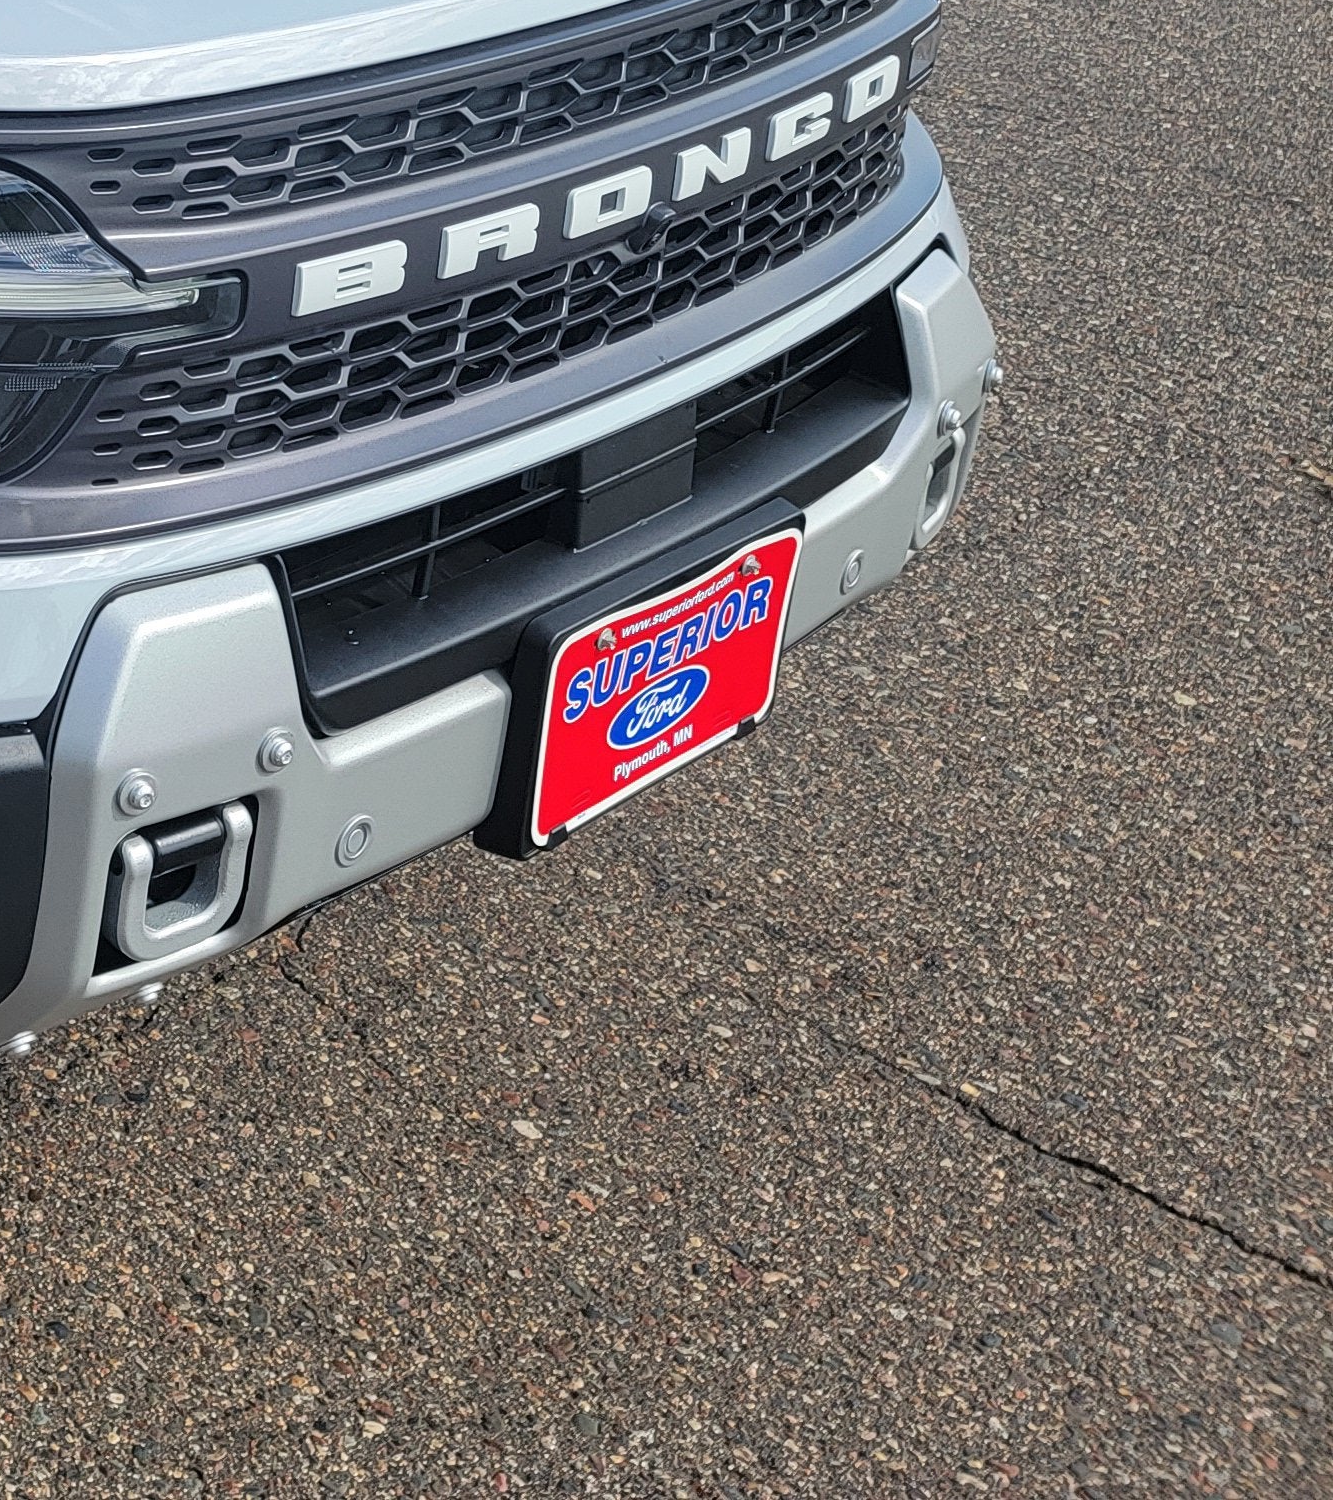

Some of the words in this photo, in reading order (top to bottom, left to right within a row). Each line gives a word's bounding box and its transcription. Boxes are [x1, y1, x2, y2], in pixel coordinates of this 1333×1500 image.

[291, 54, 900, 317] BRONCO
[621, 571, 735, 638] www.superiorford.com
[563, 576, 773, 723] SUPERIOR
[626, 676, 690, 739] Ford
[613, 739, 671, 782] Plymouth,
[673, 723, 693, 747] MN
